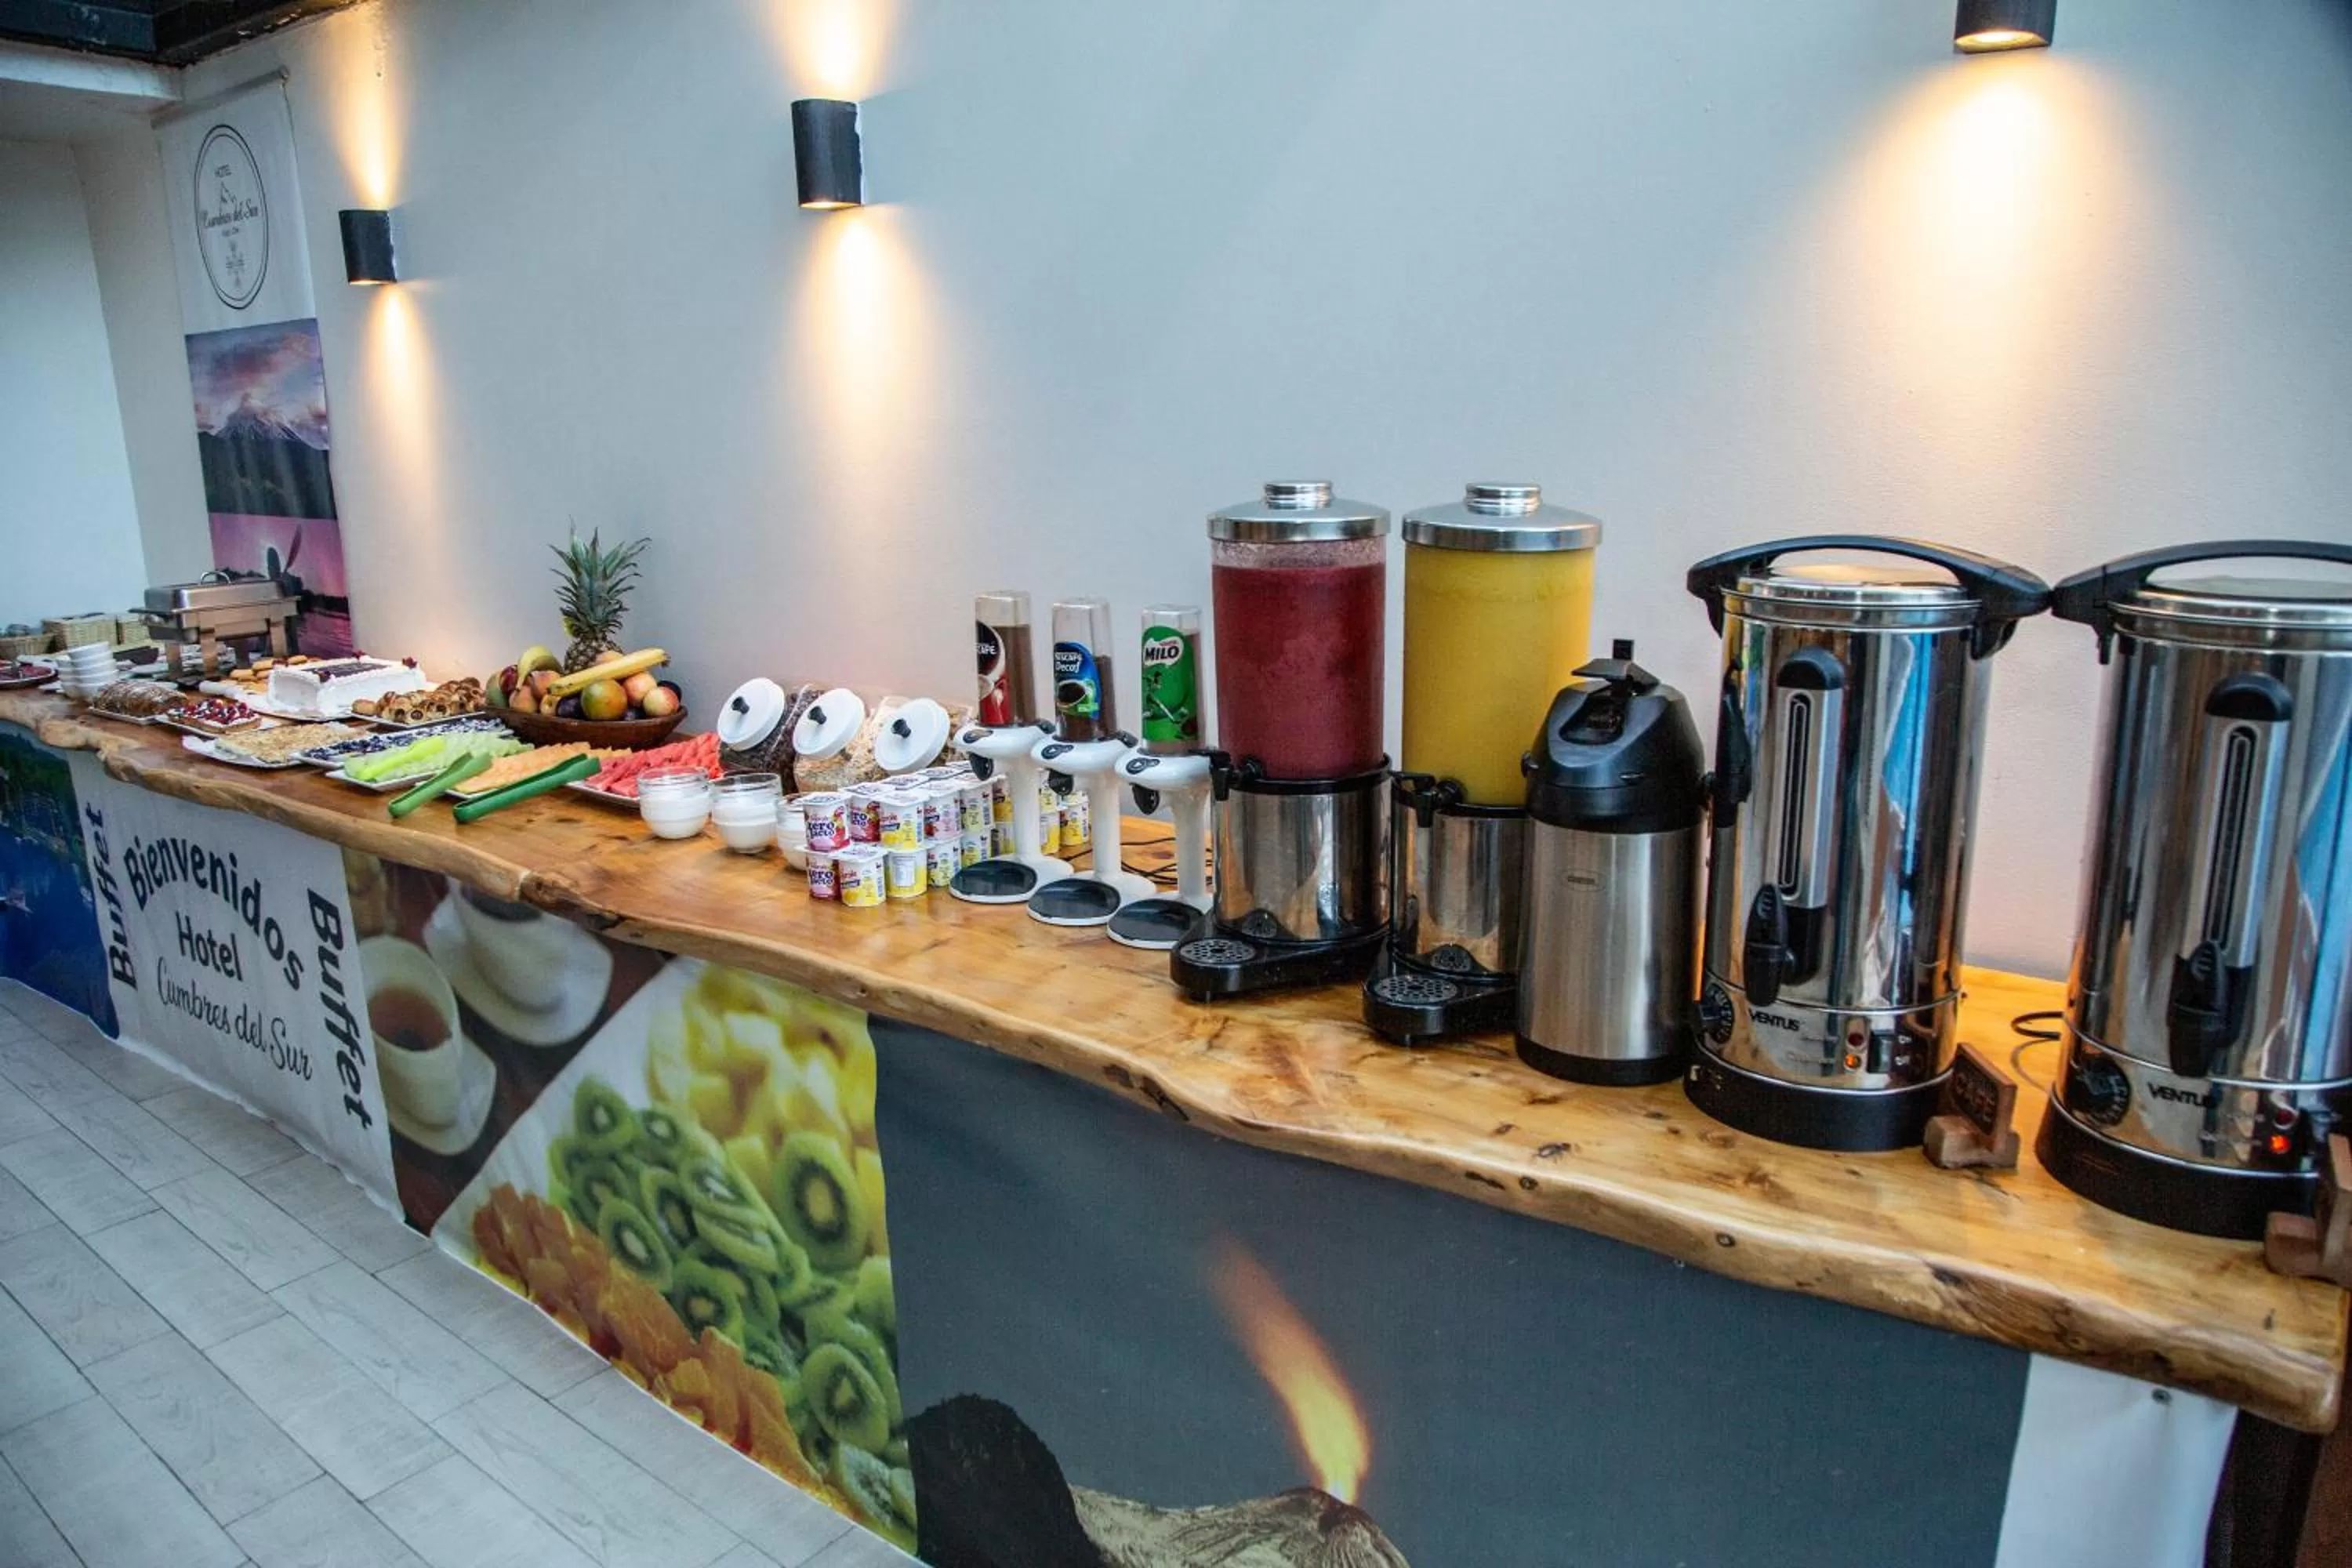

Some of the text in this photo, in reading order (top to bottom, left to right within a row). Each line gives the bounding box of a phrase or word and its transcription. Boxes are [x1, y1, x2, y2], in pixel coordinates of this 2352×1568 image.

[1056, 661, 1080, 673] Decaf
[1145, 645, 1180, 661] MILO
[86, 801, 138, 992] Buffet
[123, 835, 306, 991] Bienvenidos
[174, 910, 244, 982] Hotel
[157, 956, 313, 1081] Cumbres del Sur
[307, 887, 373, 1131] Buffet
[1749, 1008, 1800, 1032] VENTUS
[2147, 1082, 2212, 1109] VENTU
